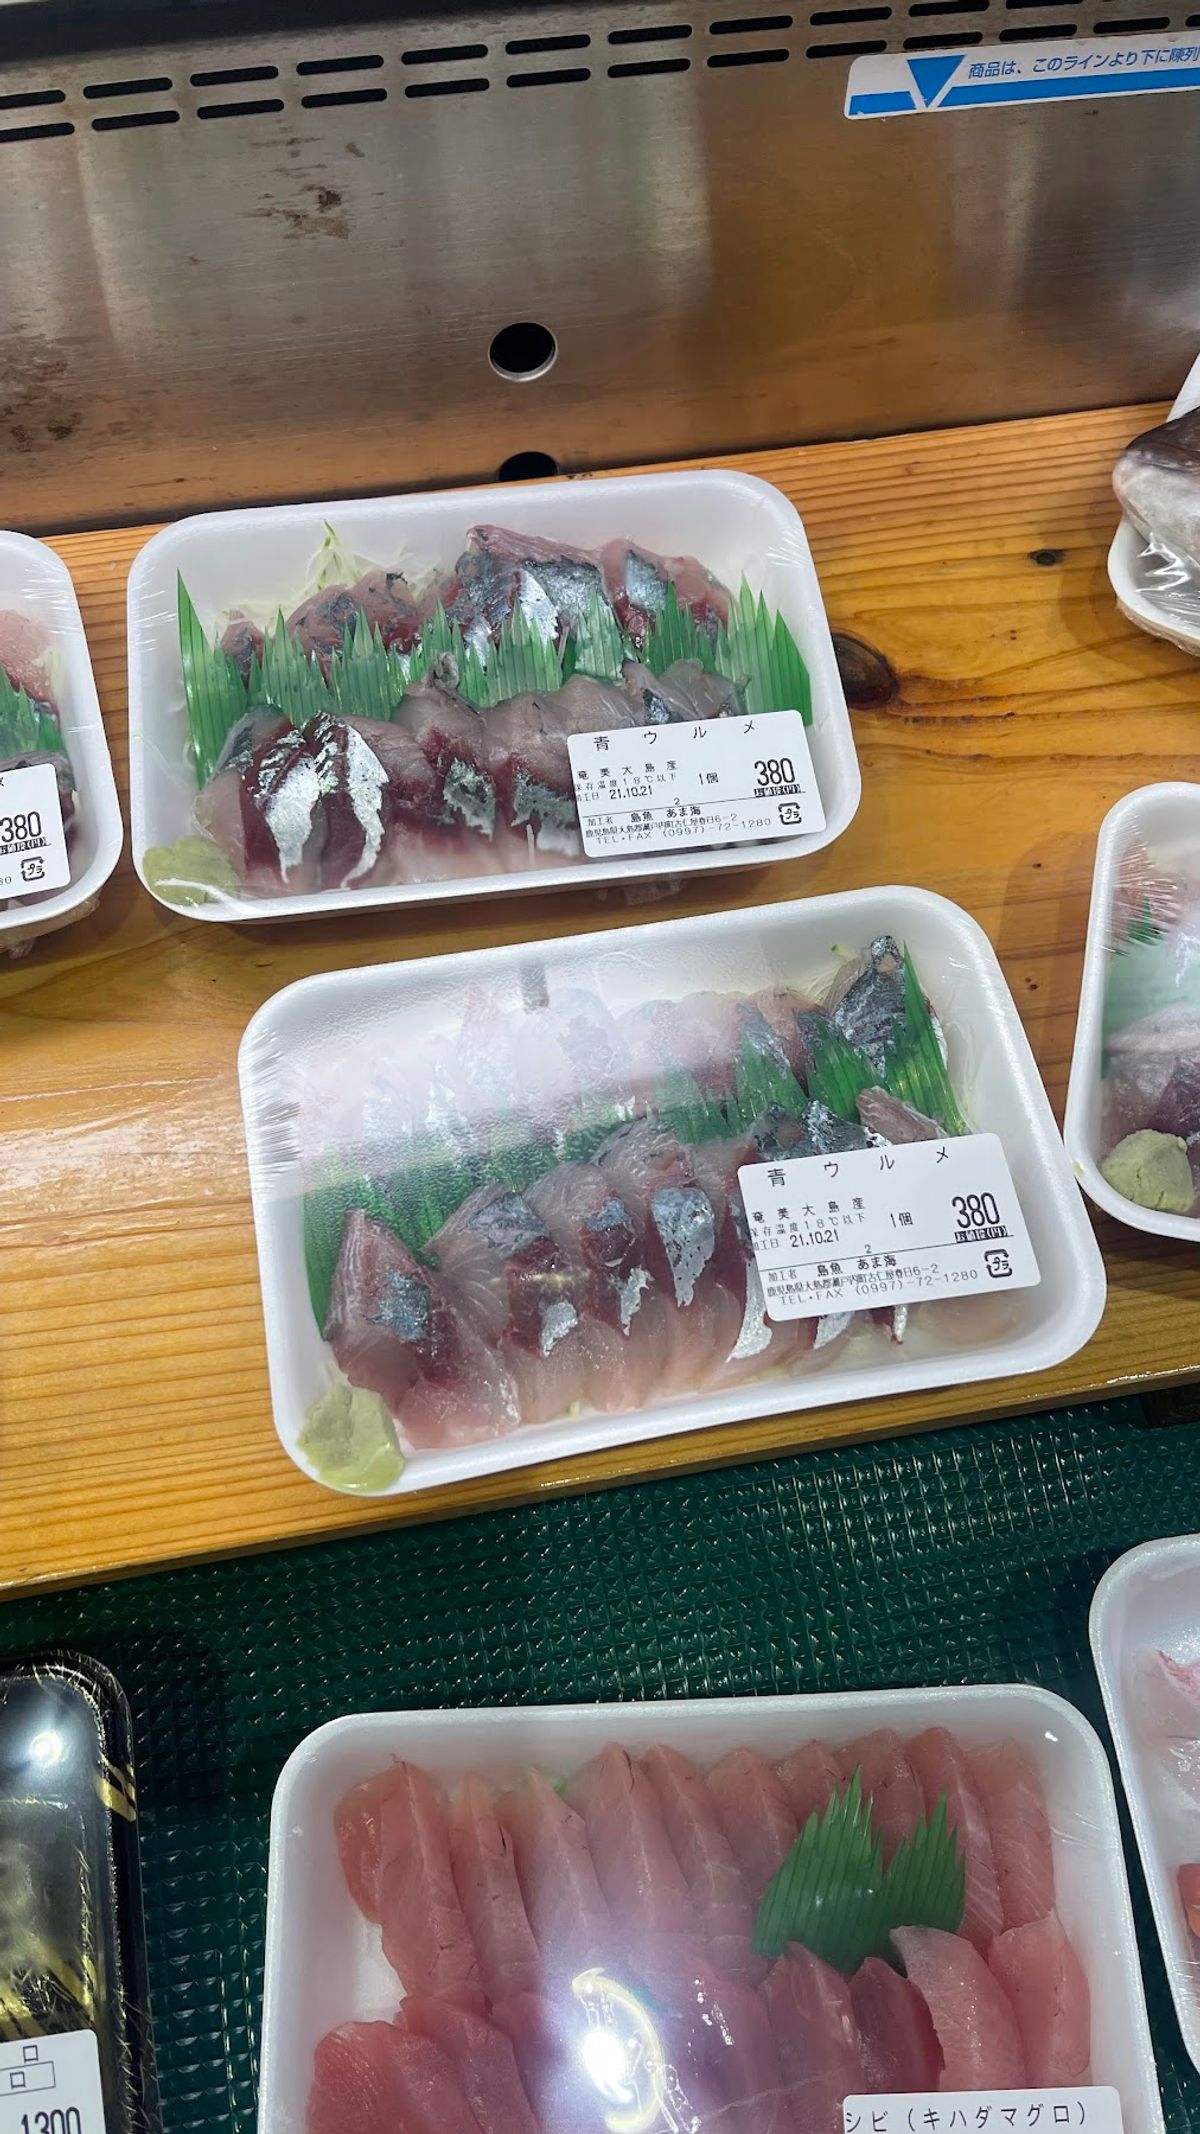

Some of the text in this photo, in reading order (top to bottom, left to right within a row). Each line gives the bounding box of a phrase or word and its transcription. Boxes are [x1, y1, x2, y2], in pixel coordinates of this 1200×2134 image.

[594, 720, 755, 752] 青ウルメ
[578, 760, 678, 780] 奄美大島産
[754, 758, 795, 786] 380
[609, 785, 653, 800] 21.10.21
[674, 797, 680, 805] 2
[767, 1146, 949, 1187] 青ウルメ
[753, 1198, 865, 1223] 奄美大島産
[952, 1192, 1000, 1228] 380
[790, 1228, 839, 1247] 21.10.21
[864, 1244, 872, 1254] 2
